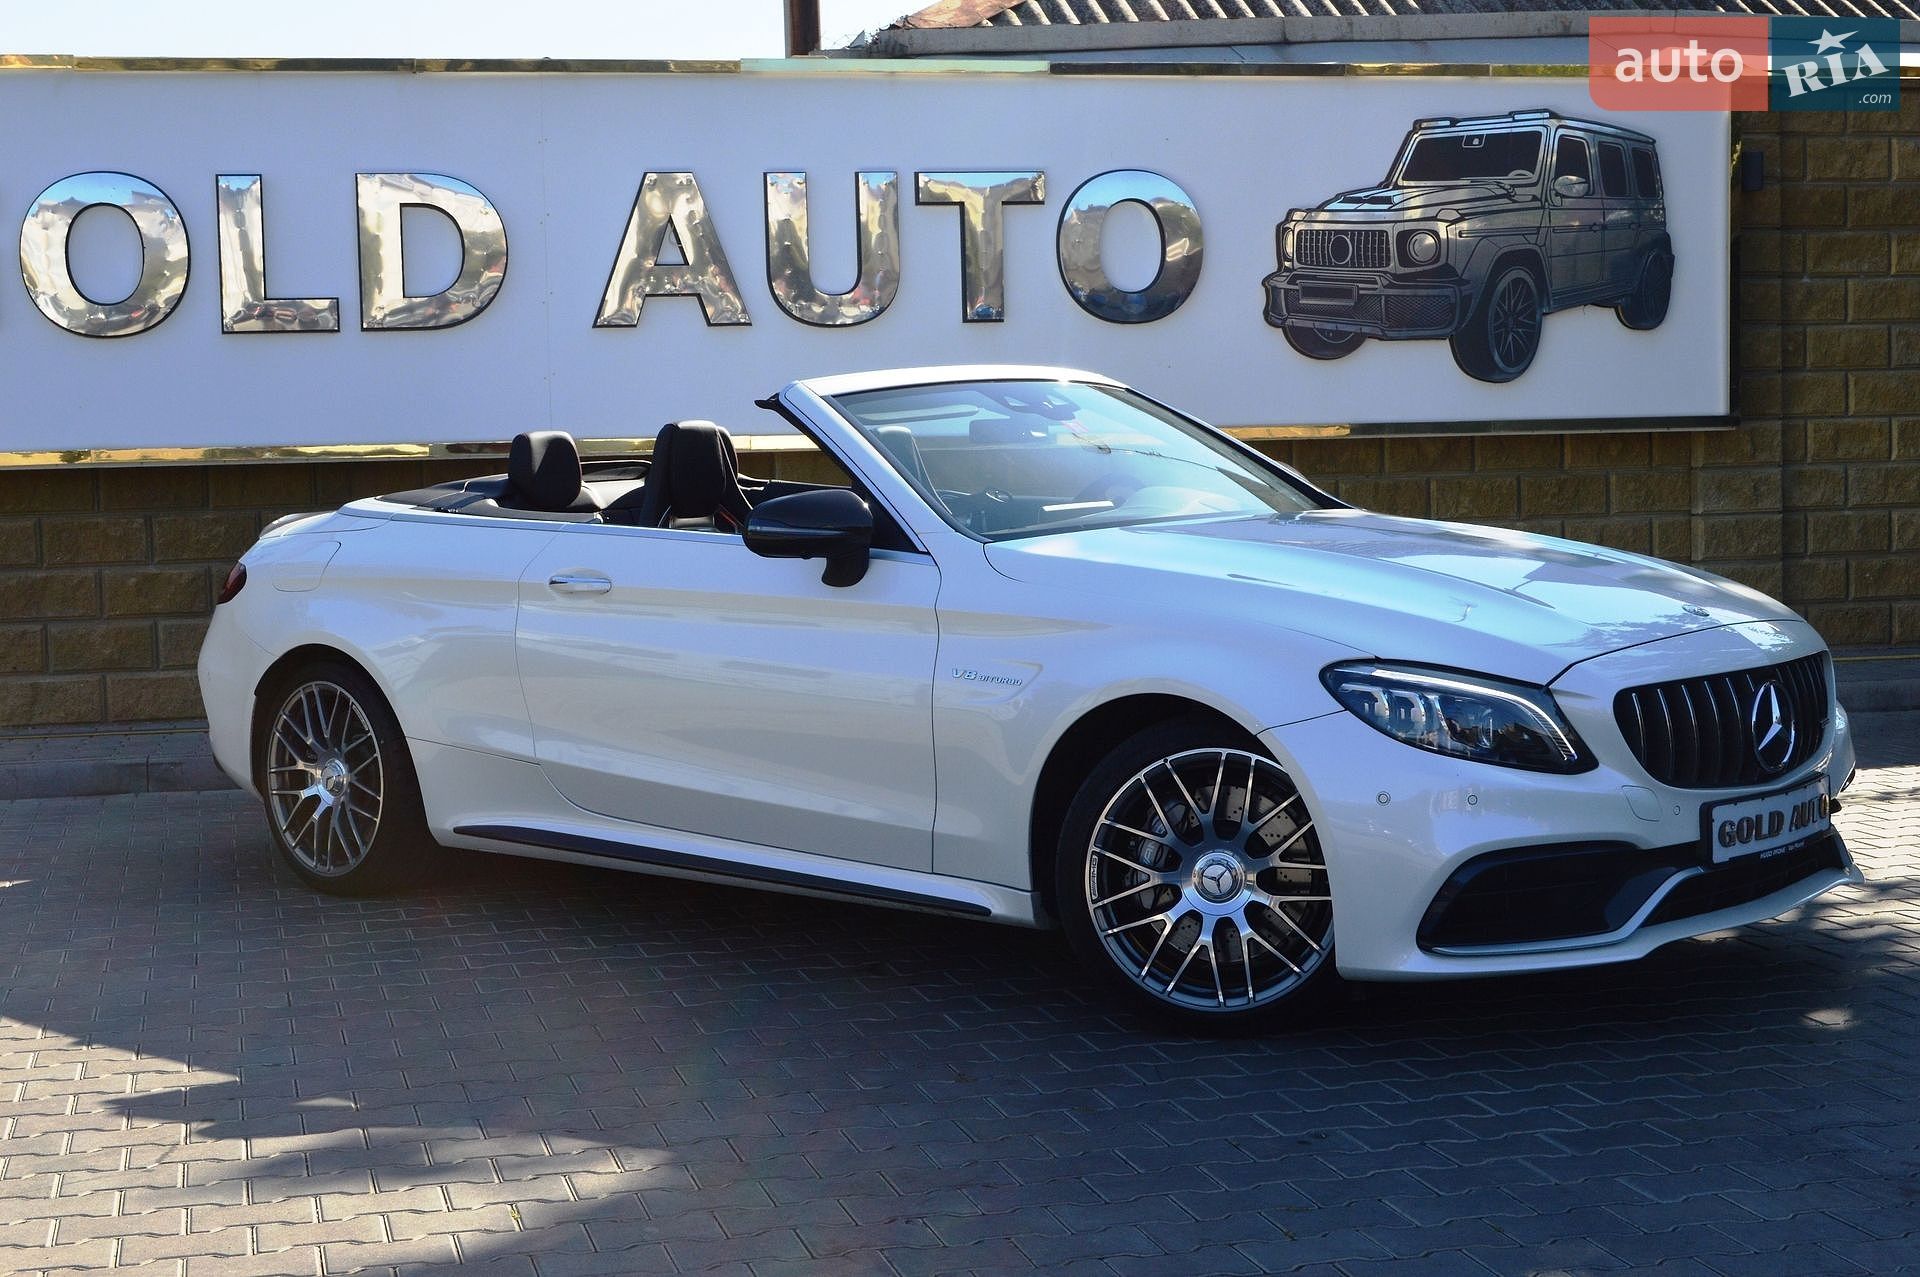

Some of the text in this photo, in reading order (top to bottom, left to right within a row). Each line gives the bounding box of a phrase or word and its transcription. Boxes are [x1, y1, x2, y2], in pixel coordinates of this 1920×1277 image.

[592, 168, 1204, 328] AUTO
[952, 668, 977, 680] V8
[1718, 793, 1830, 848] GOLD AUTO
